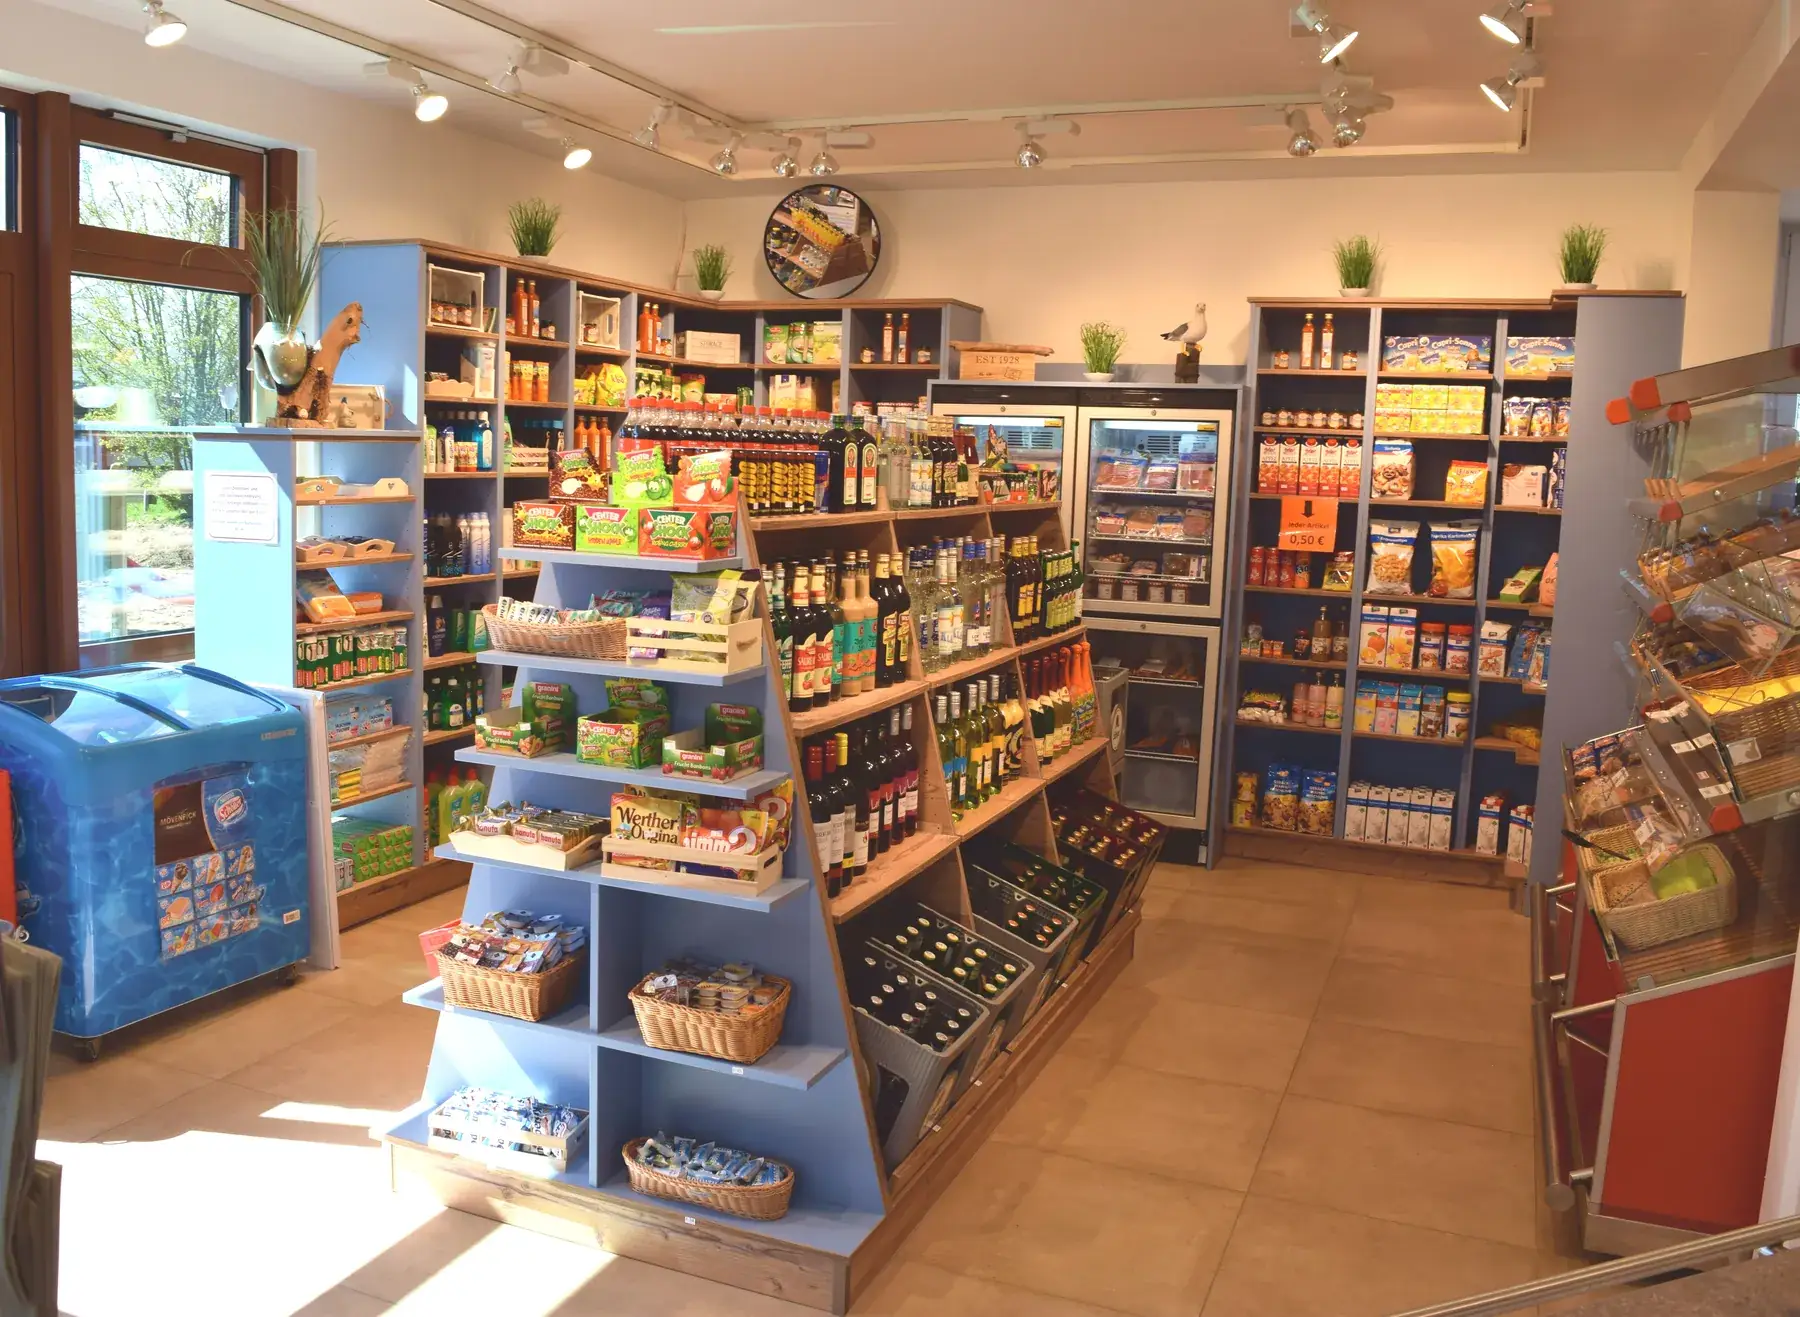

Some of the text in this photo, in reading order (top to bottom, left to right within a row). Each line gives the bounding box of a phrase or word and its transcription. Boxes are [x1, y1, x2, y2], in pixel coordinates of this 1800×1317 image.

[1431, 336, 1477, 350] Capri-Sonne
[1520, 339, 1566, 351] Capri-Sonne
[975, 355, 1020, 364] EST 1928
[528, 507, 556, 518] CENTER
[591, 511, 620, 522] CENTER
[656, 514, 686, 524] CENTER
[1307, 520, 1330, 529] Artikel
[650, 523, 692, 538] SHOCK
[1290, 534, 1325, 546] 0,50 €
[537, 685, 560, 693] granini
[721, 705, 746, 716] granini
[491, 729, 511, 737] granini
[592, 726, 616, 735] CENTER
[681, 753, 703, 761] granini
[673, 760, 689, 769] Frucht
[160, 811, 197, 826] MÖVENPICK
[514, 828, 536, 839] hanuta
[540, 833, 562, 845] hanuta
